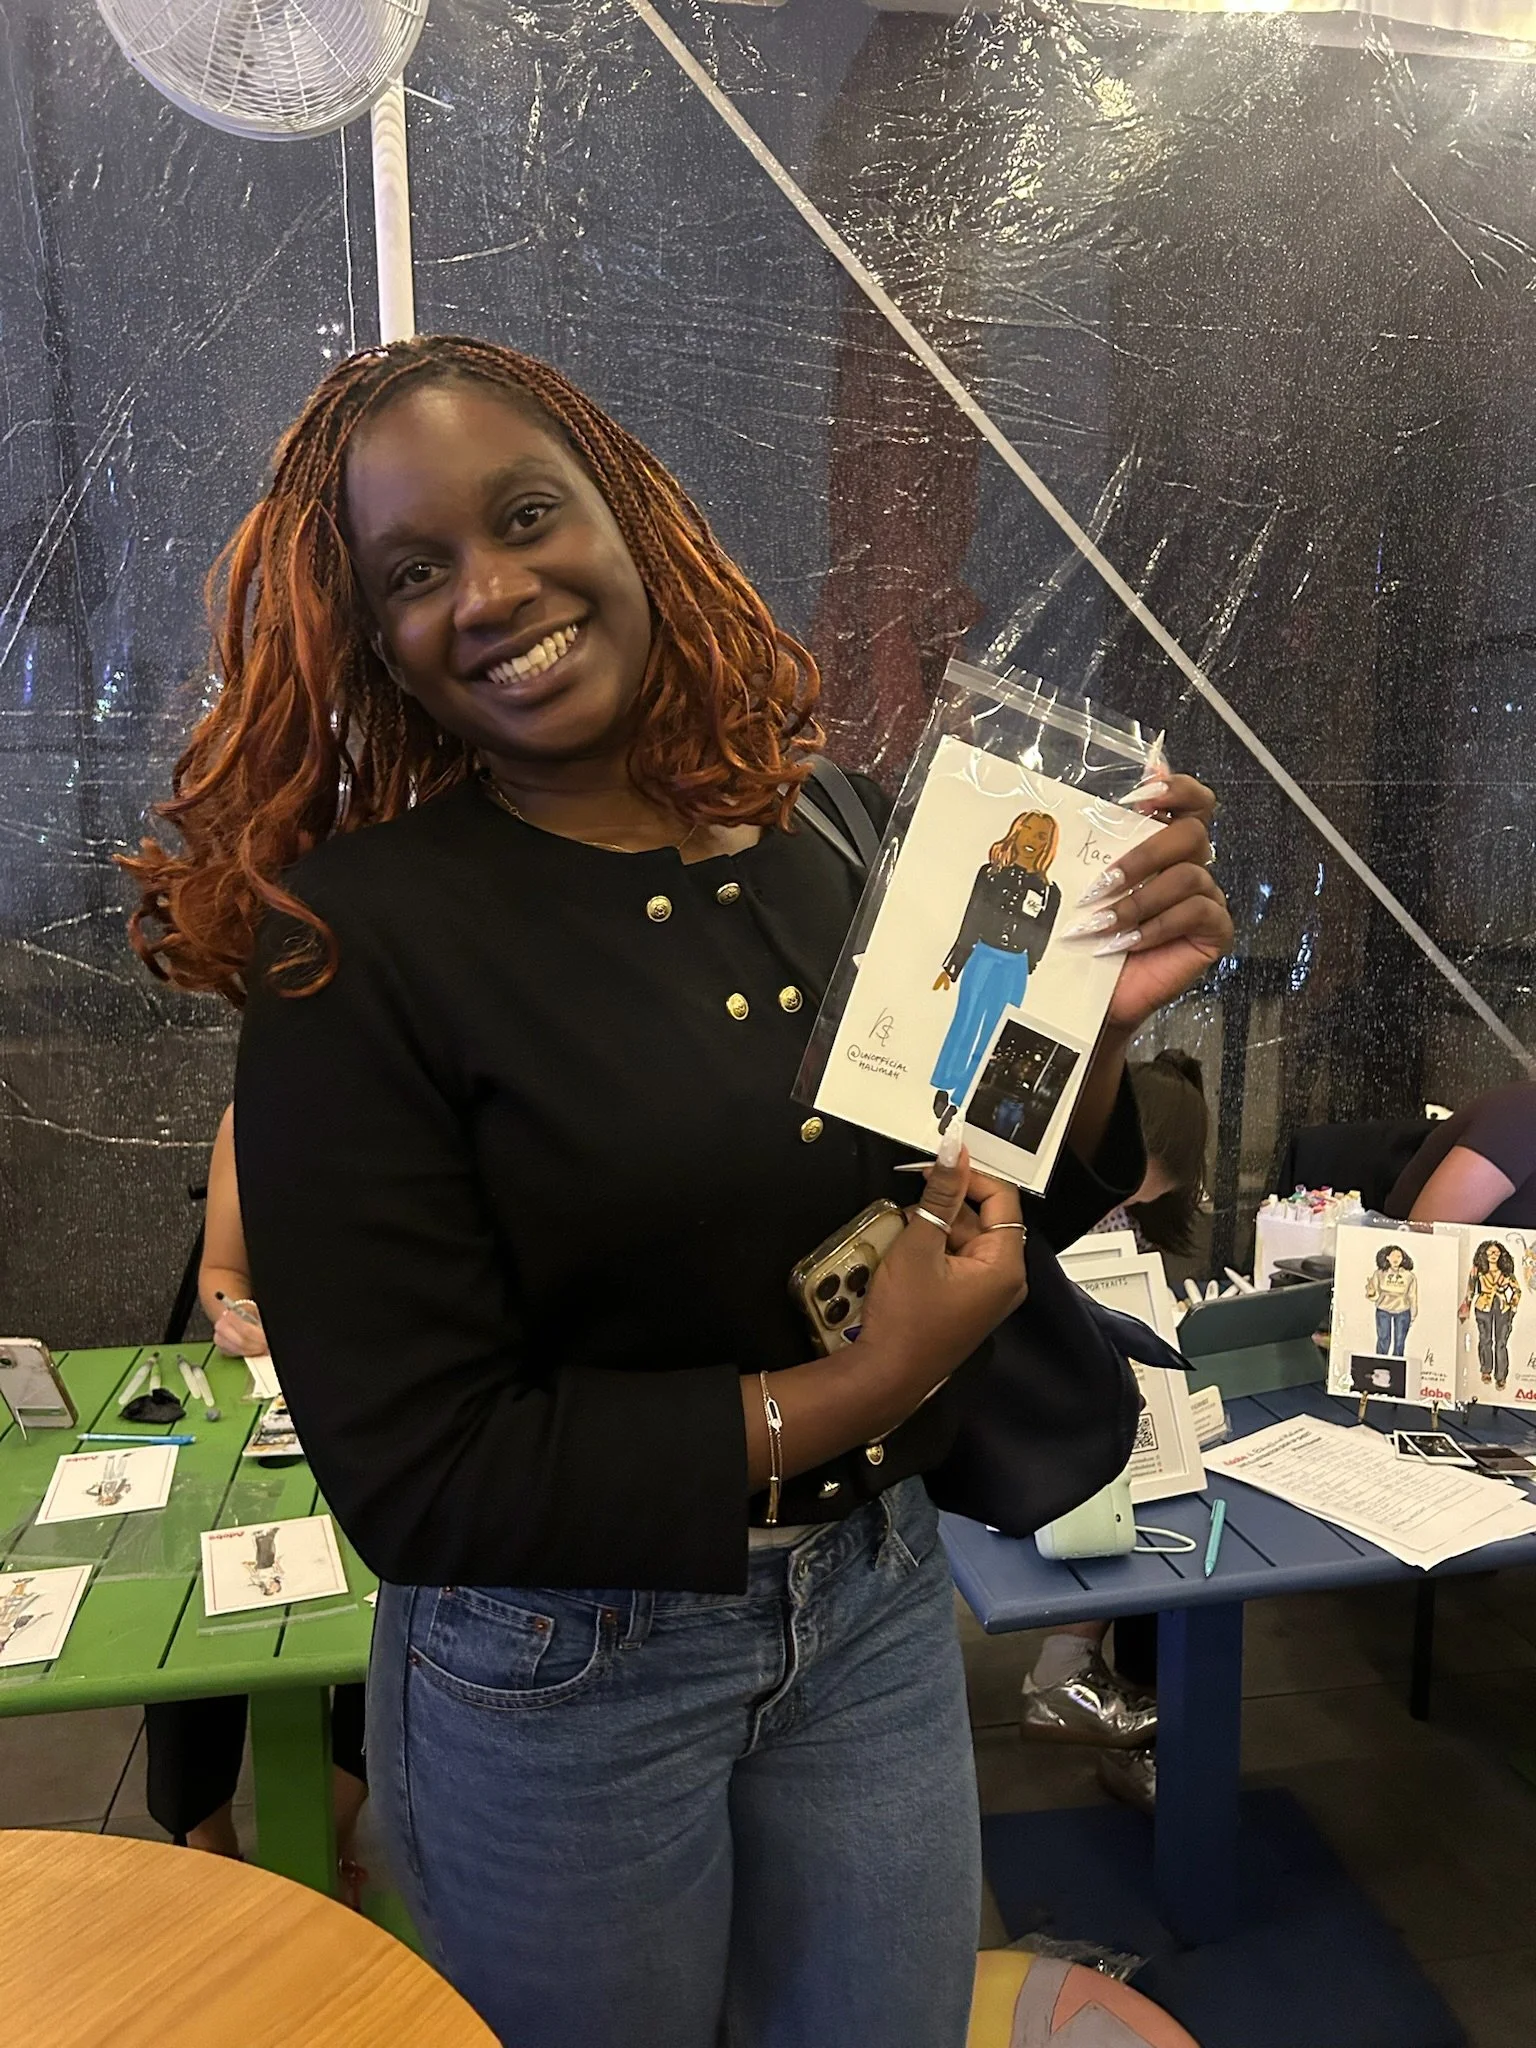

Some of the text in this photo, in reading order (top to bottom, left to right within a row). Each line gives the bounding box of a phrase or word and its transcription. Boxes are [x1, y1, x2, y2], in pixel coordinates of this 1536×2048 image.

[1076, 829, 1112, 866] Kae
[846, 1044, 908, 1073] @UNOFFICIAL
[1420, 1386, 1452, 1400] dobe
